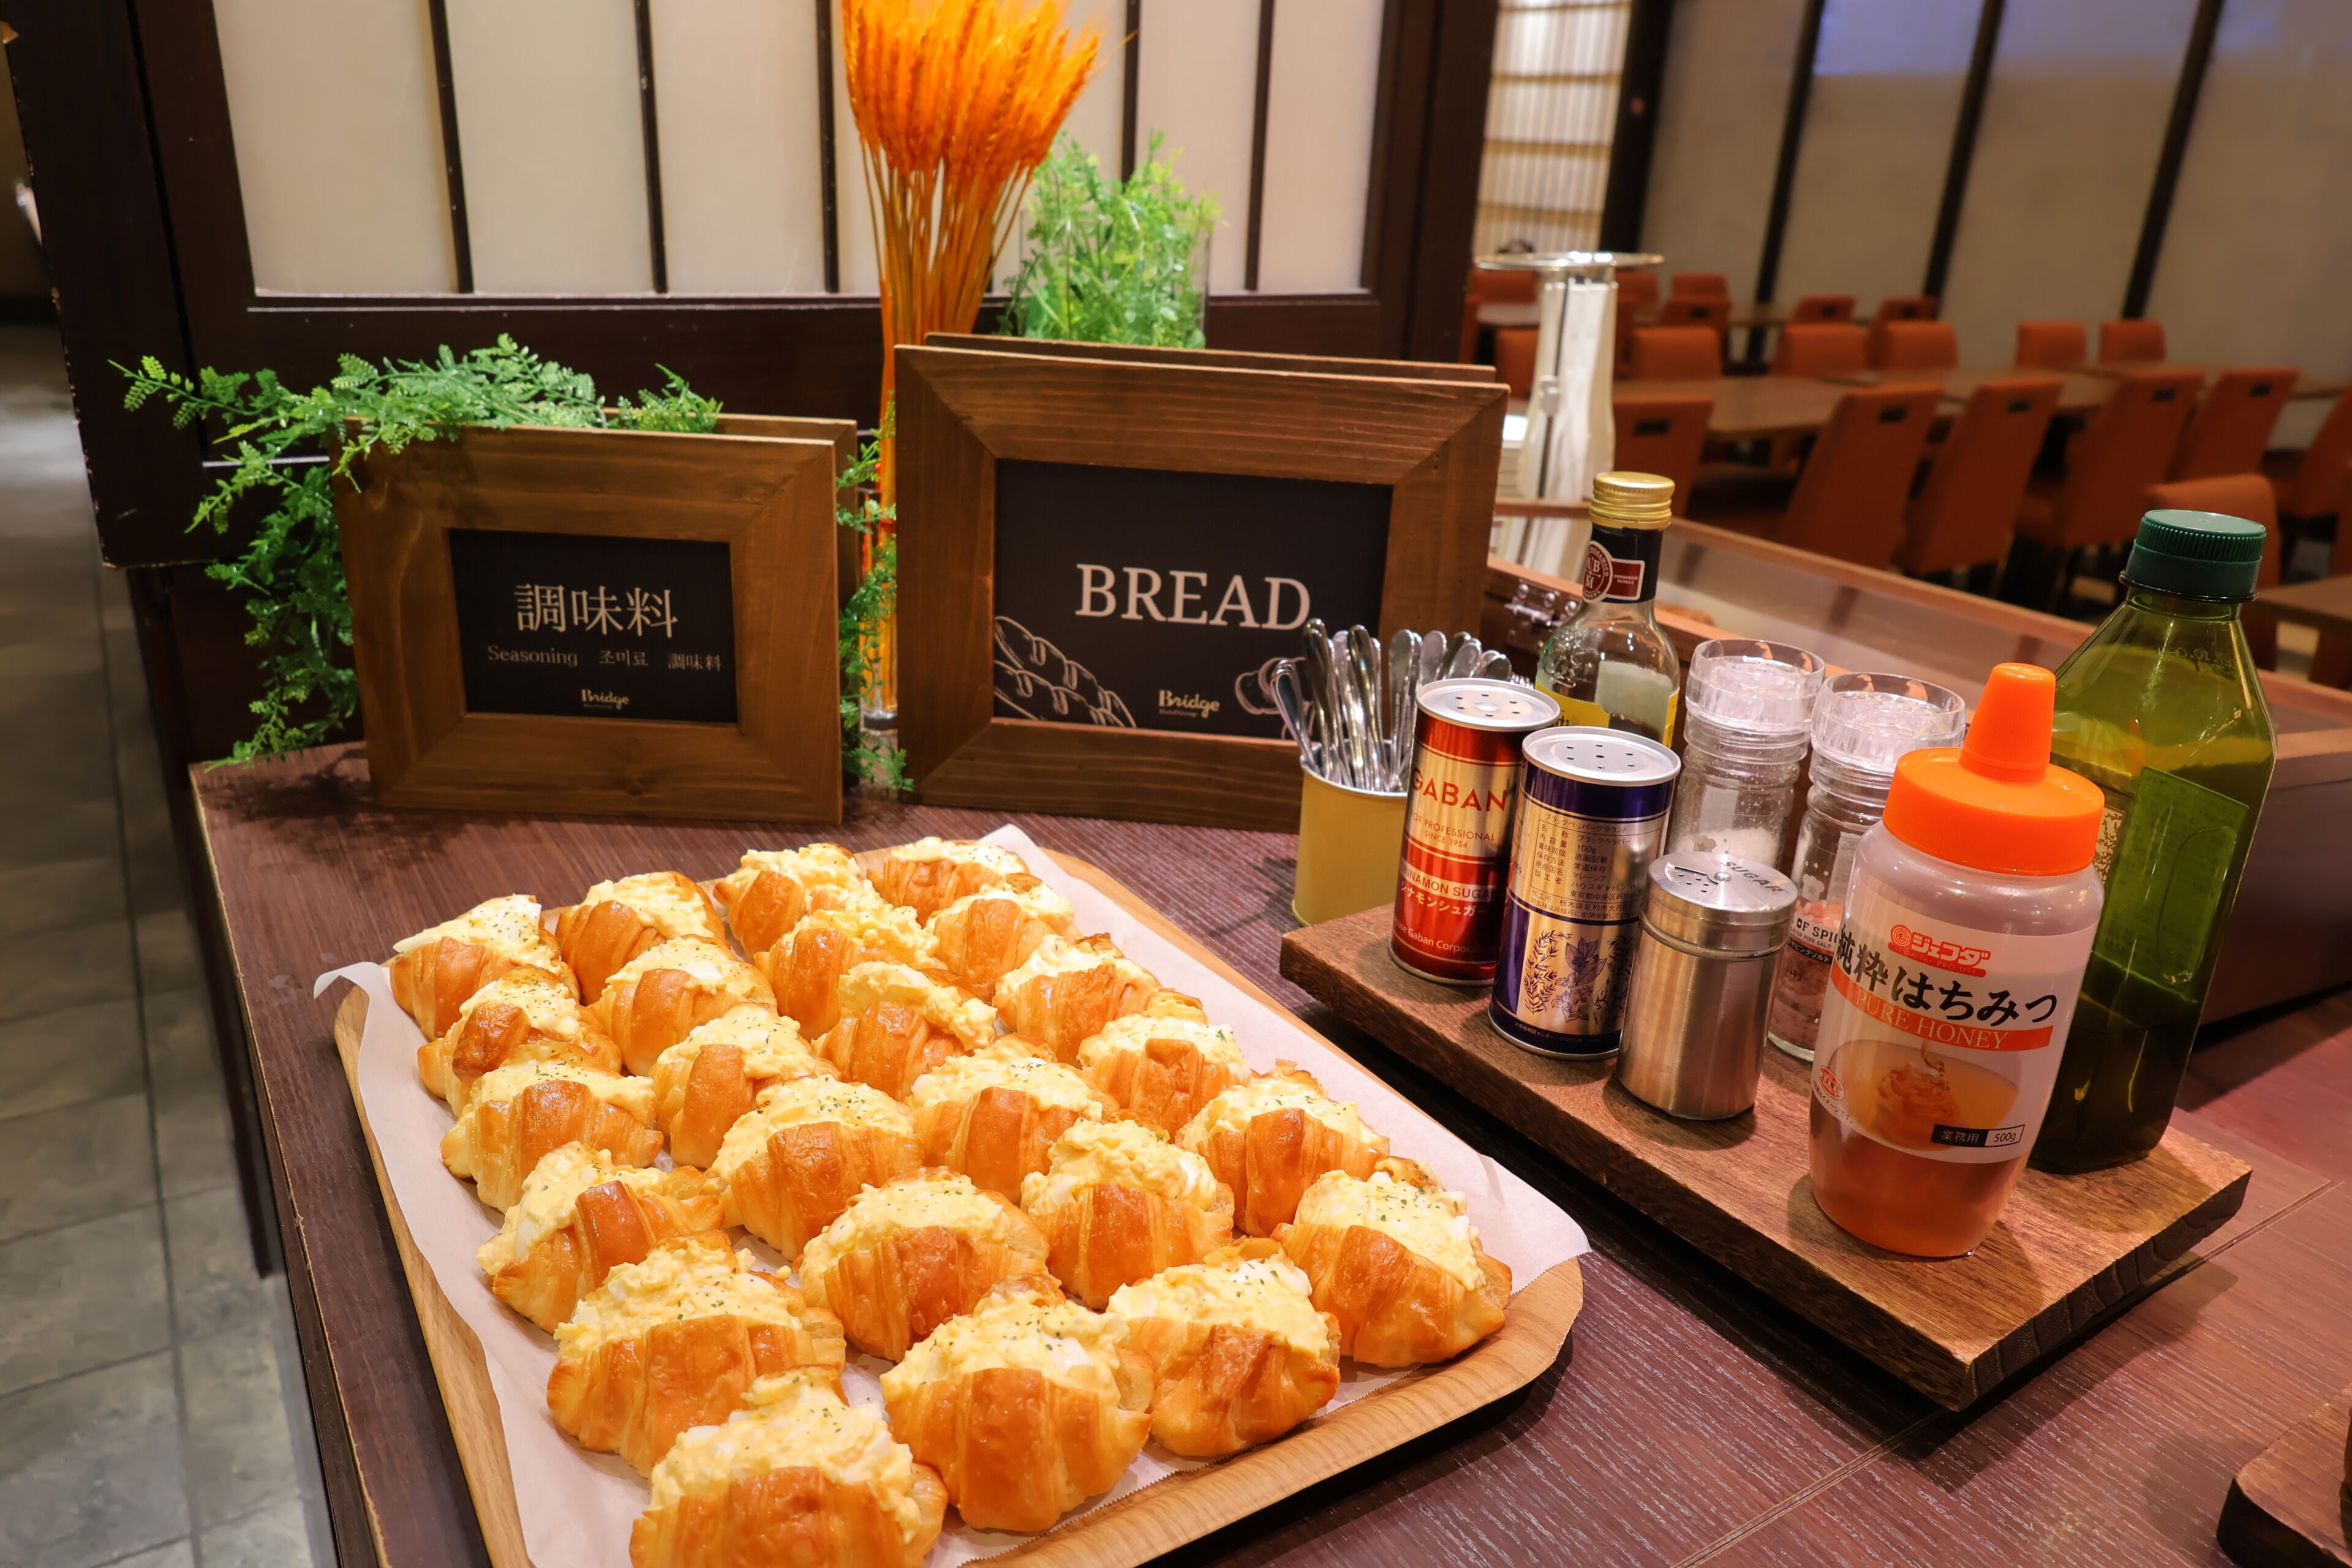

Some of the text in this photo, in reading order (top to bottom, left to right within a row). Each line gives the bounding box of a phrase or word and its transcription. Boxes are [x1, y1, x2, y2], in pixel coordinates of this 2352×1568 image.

[1076, 563, 1311, 631] BREAD
[513, 583, 678, 638] 調味料
[488, 645, 578, 667] Seasoning
[598, 649, 649, 667] 조미료
[667, 653, 722, 671] 調味料
[581, 688, 630, 710] Bridge
[1159, 690, 1220, 718] Bridge
[1411, 767, 1508, 812] GABAN
[1424, 819, 1495, 841] PROFESSIONAL
[1544, 813, 1628, 834] ブラックペッパーグラウンド
[1425, 830, 1468, 848] SINCE 1954
[1577, 845, 1597, 854] 100g
[1578, 834, 1631, 845] ブラックペッパー
[1537, 851, 1566, 867] 保存方法
[1572, 872, 1607, 882] マレーシア
[1721, 861, 1784, 892] SUGAR
[1401, 880, 1488, 916] シナモンシュガー
[1796, 918, 1809, 932] OF
[1408, 927, 1434, 946] Gaban
[1817, 940, 1831, 949] SALT
[1910, 933, 1990, 967] ジェフダ
[1836, 923, 2057, 1027] 純粋はちみつ
[1920, 955, 1932, 963] for
[1937, 960, 1956, 970] PRO
[1959, 967, 1977, 976] USE
[1856, 989, 2010, 1049] PURE HONEY
[1940, 1130, 2017, 1144] 業務用 500g
